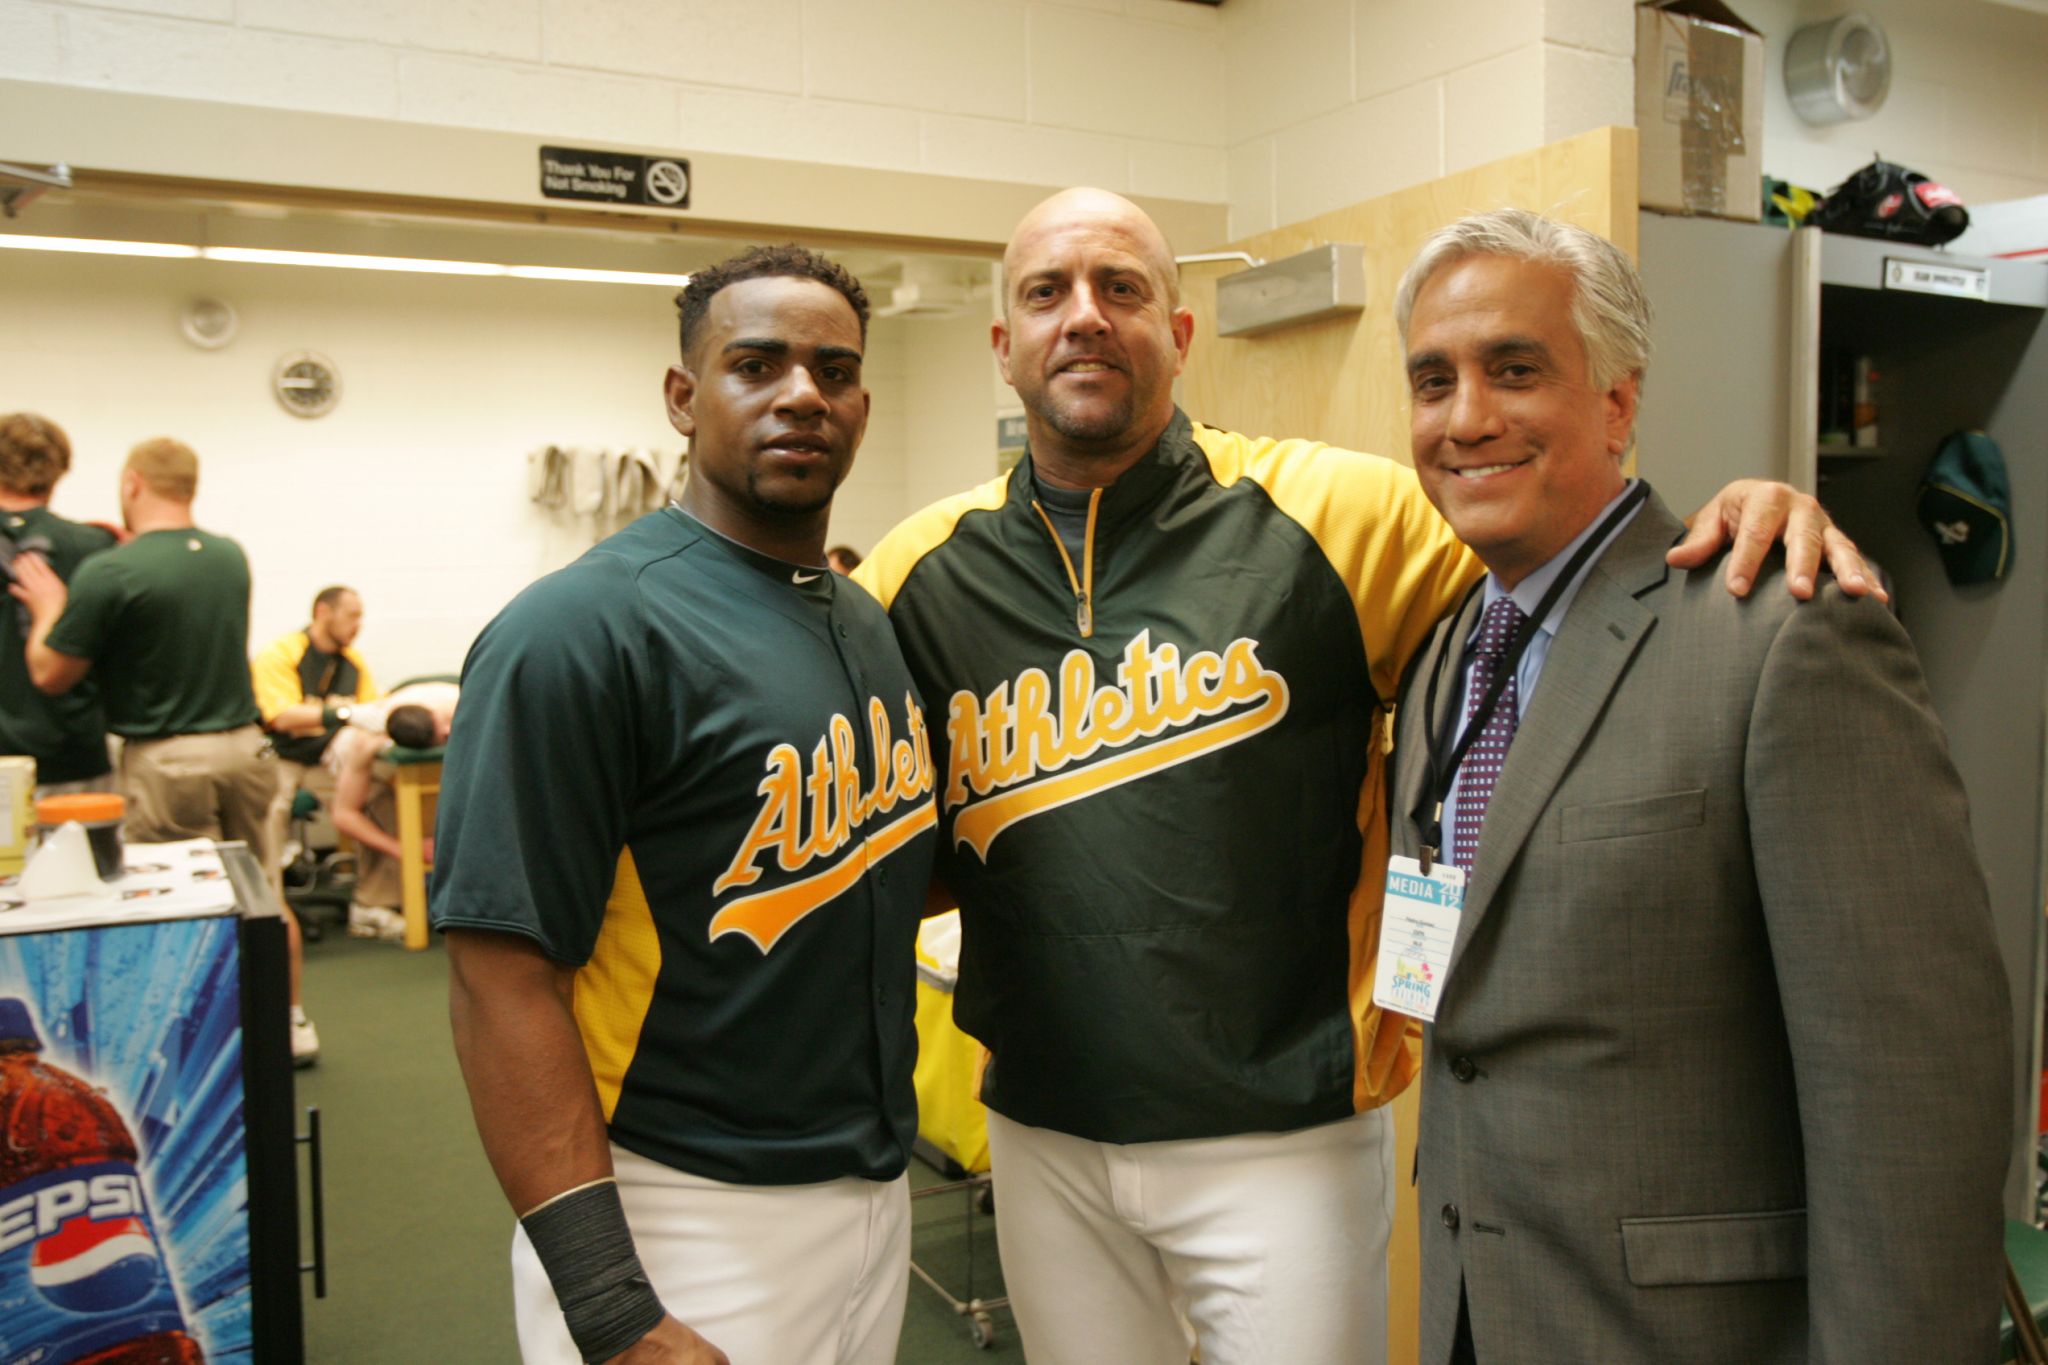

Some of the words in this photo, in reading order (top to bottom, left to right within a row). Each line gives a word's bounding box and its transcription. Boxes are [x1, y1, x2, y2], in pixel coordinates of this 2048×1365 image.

[545, 159, 586, 177] Thank
[588, 164, 612, 180] You
[613, 166, 636, 182] For
[545, 175, 569, 191] Not
[571, 178, 627, 199] Smoking
[944, 628, 1278, 815] Athletics
[1388, 875, 1434, 899] MEDIA
[1391, 975, 1432, 999] SPRING
[0, 1173, 145, 1251] EPSI
